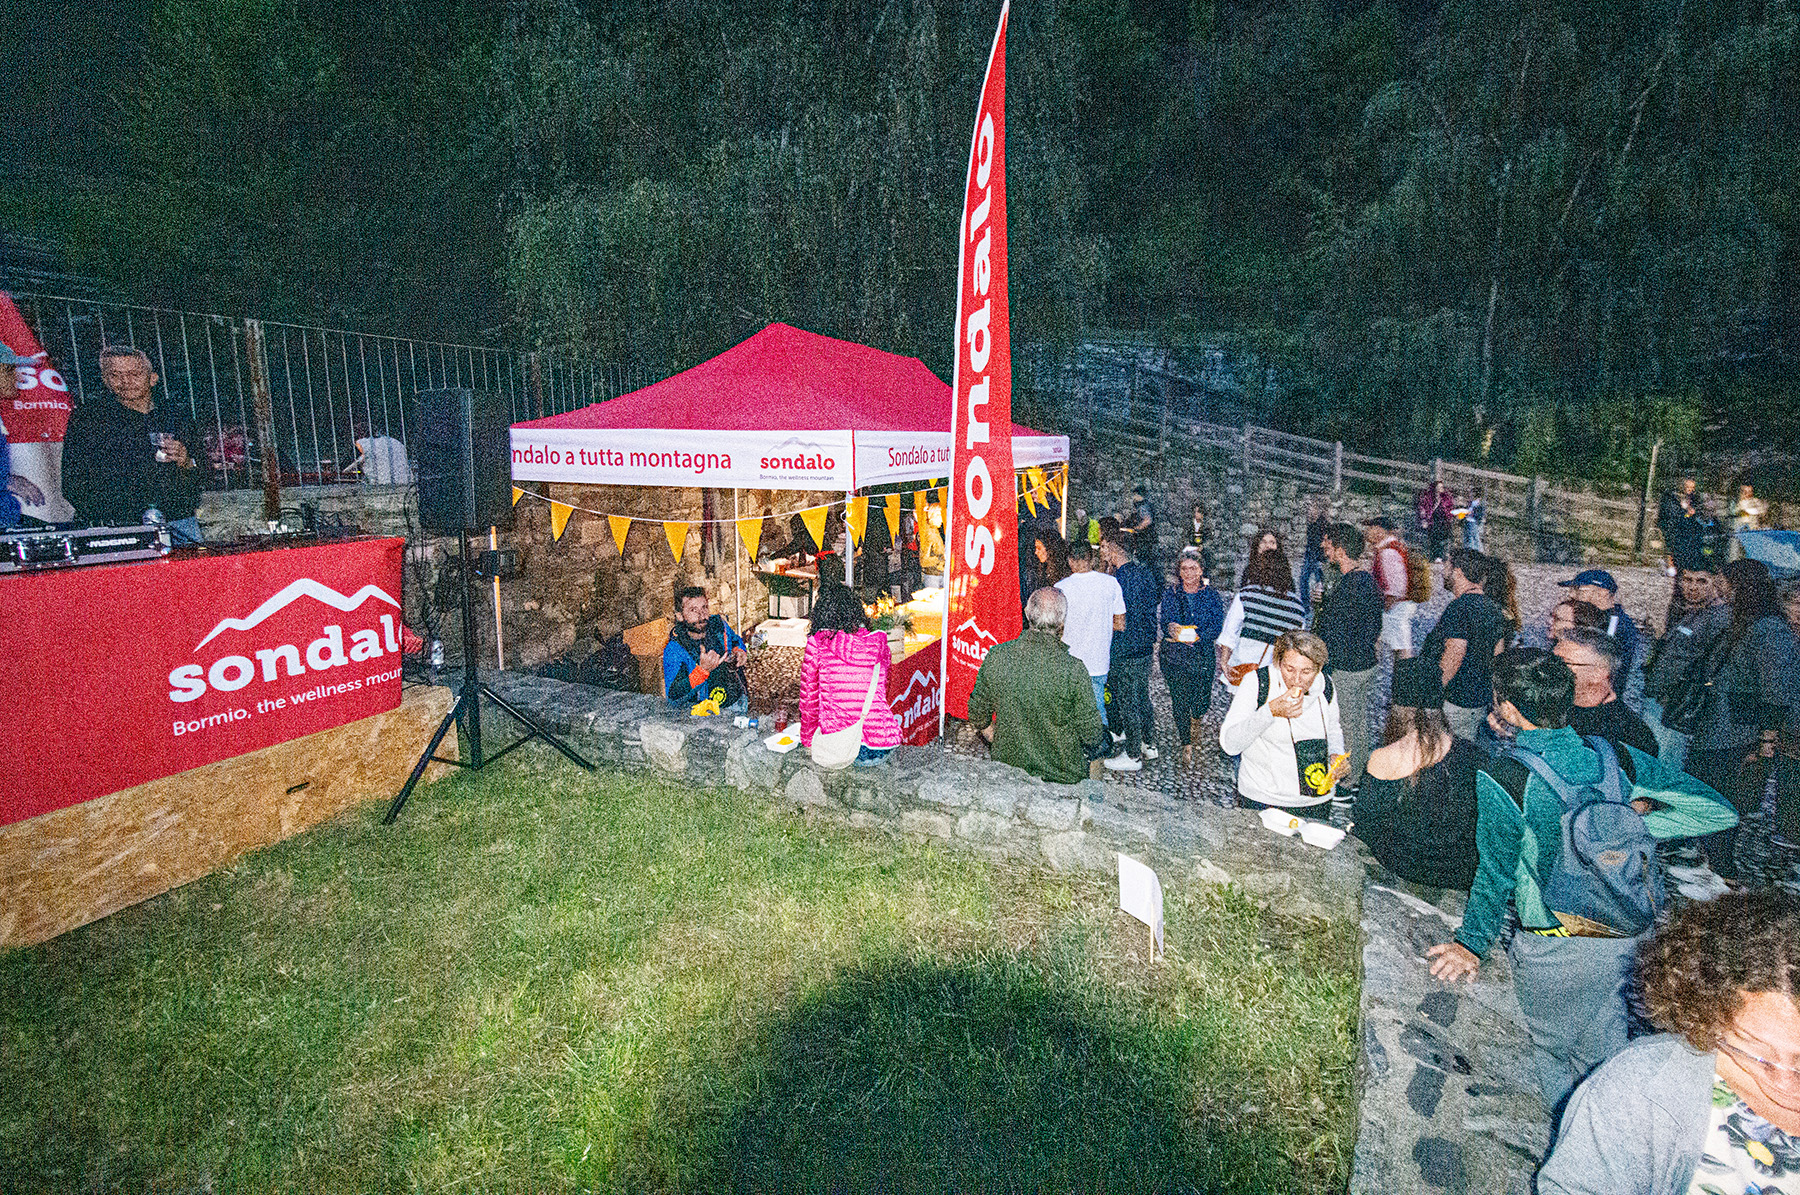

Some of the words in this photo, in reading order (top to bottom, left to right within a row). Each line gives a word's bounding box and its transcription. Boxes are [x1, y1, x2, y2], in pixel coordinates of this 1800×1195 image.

[964, 111, 995, 577] sondalo
[512, 445, 560, 464] ndalo
[565, 451, 575, 465] a
[579, 448, 624, 467] tutta
[630, 450, 732, 474] montagna
[760, 453, 835, 470] sondalo
[888, 445, 929, 467] Sondalo
[930, 450, 936, 463] a
[937, 446, 950, 462] tut
[168, 614, 402, 703] sondal
[172, 706, 251, 736] Bormio,
[257, 695, 286, 714] the
[290, 679, 362, 704] wellness
